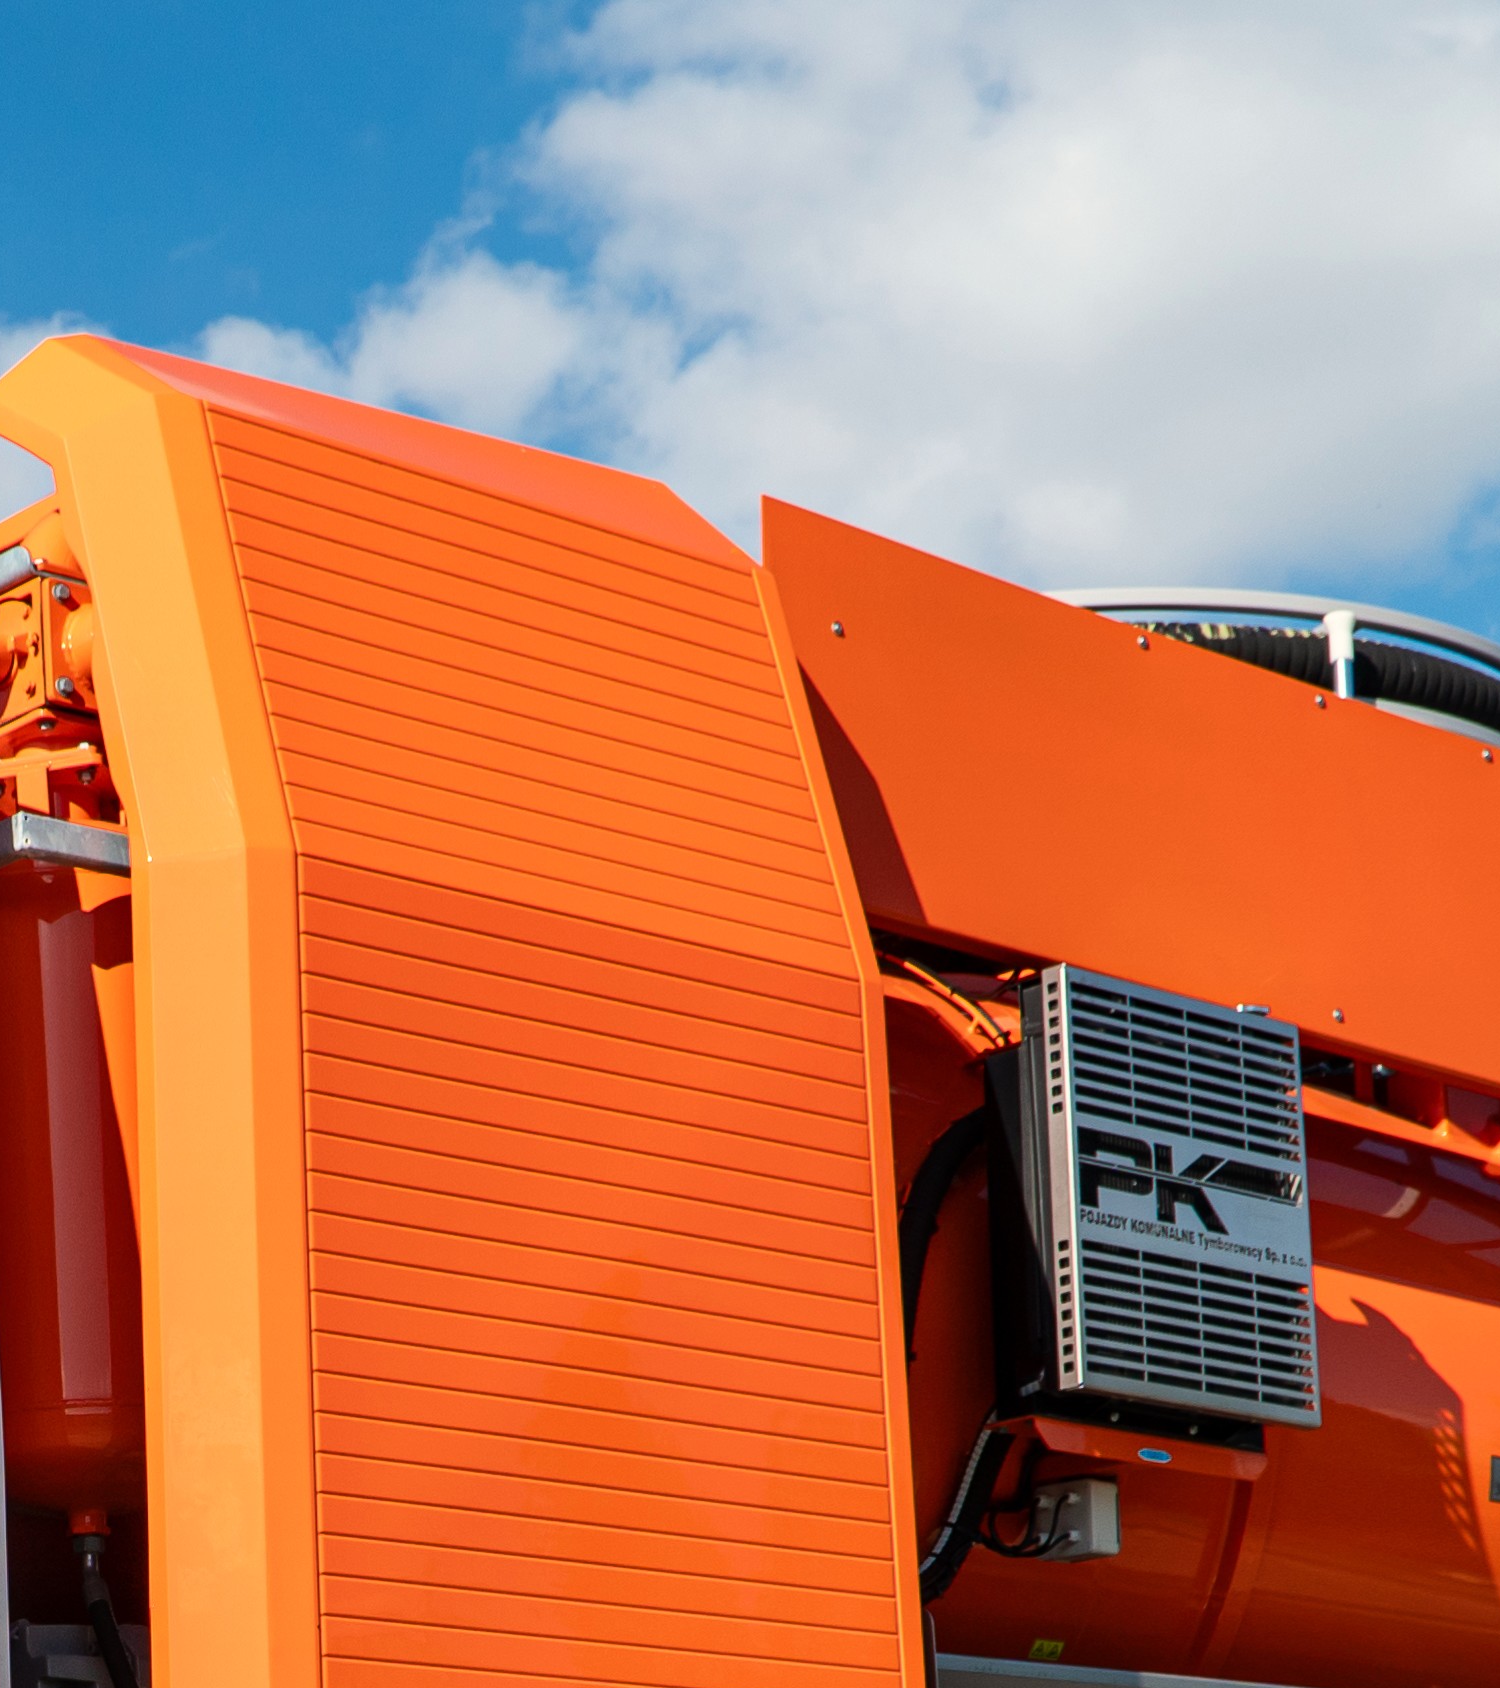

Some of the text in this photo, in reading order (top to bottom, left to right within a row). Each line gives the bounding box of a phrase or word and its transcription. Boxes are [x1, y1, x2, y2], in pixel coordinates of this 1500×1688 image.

[1077, 1126, 1229, 1235] PK
[1080, 1209, 1127, 1231] POJAZDY
[1131, 1218, 1195, 1245] KOMUNALNE
